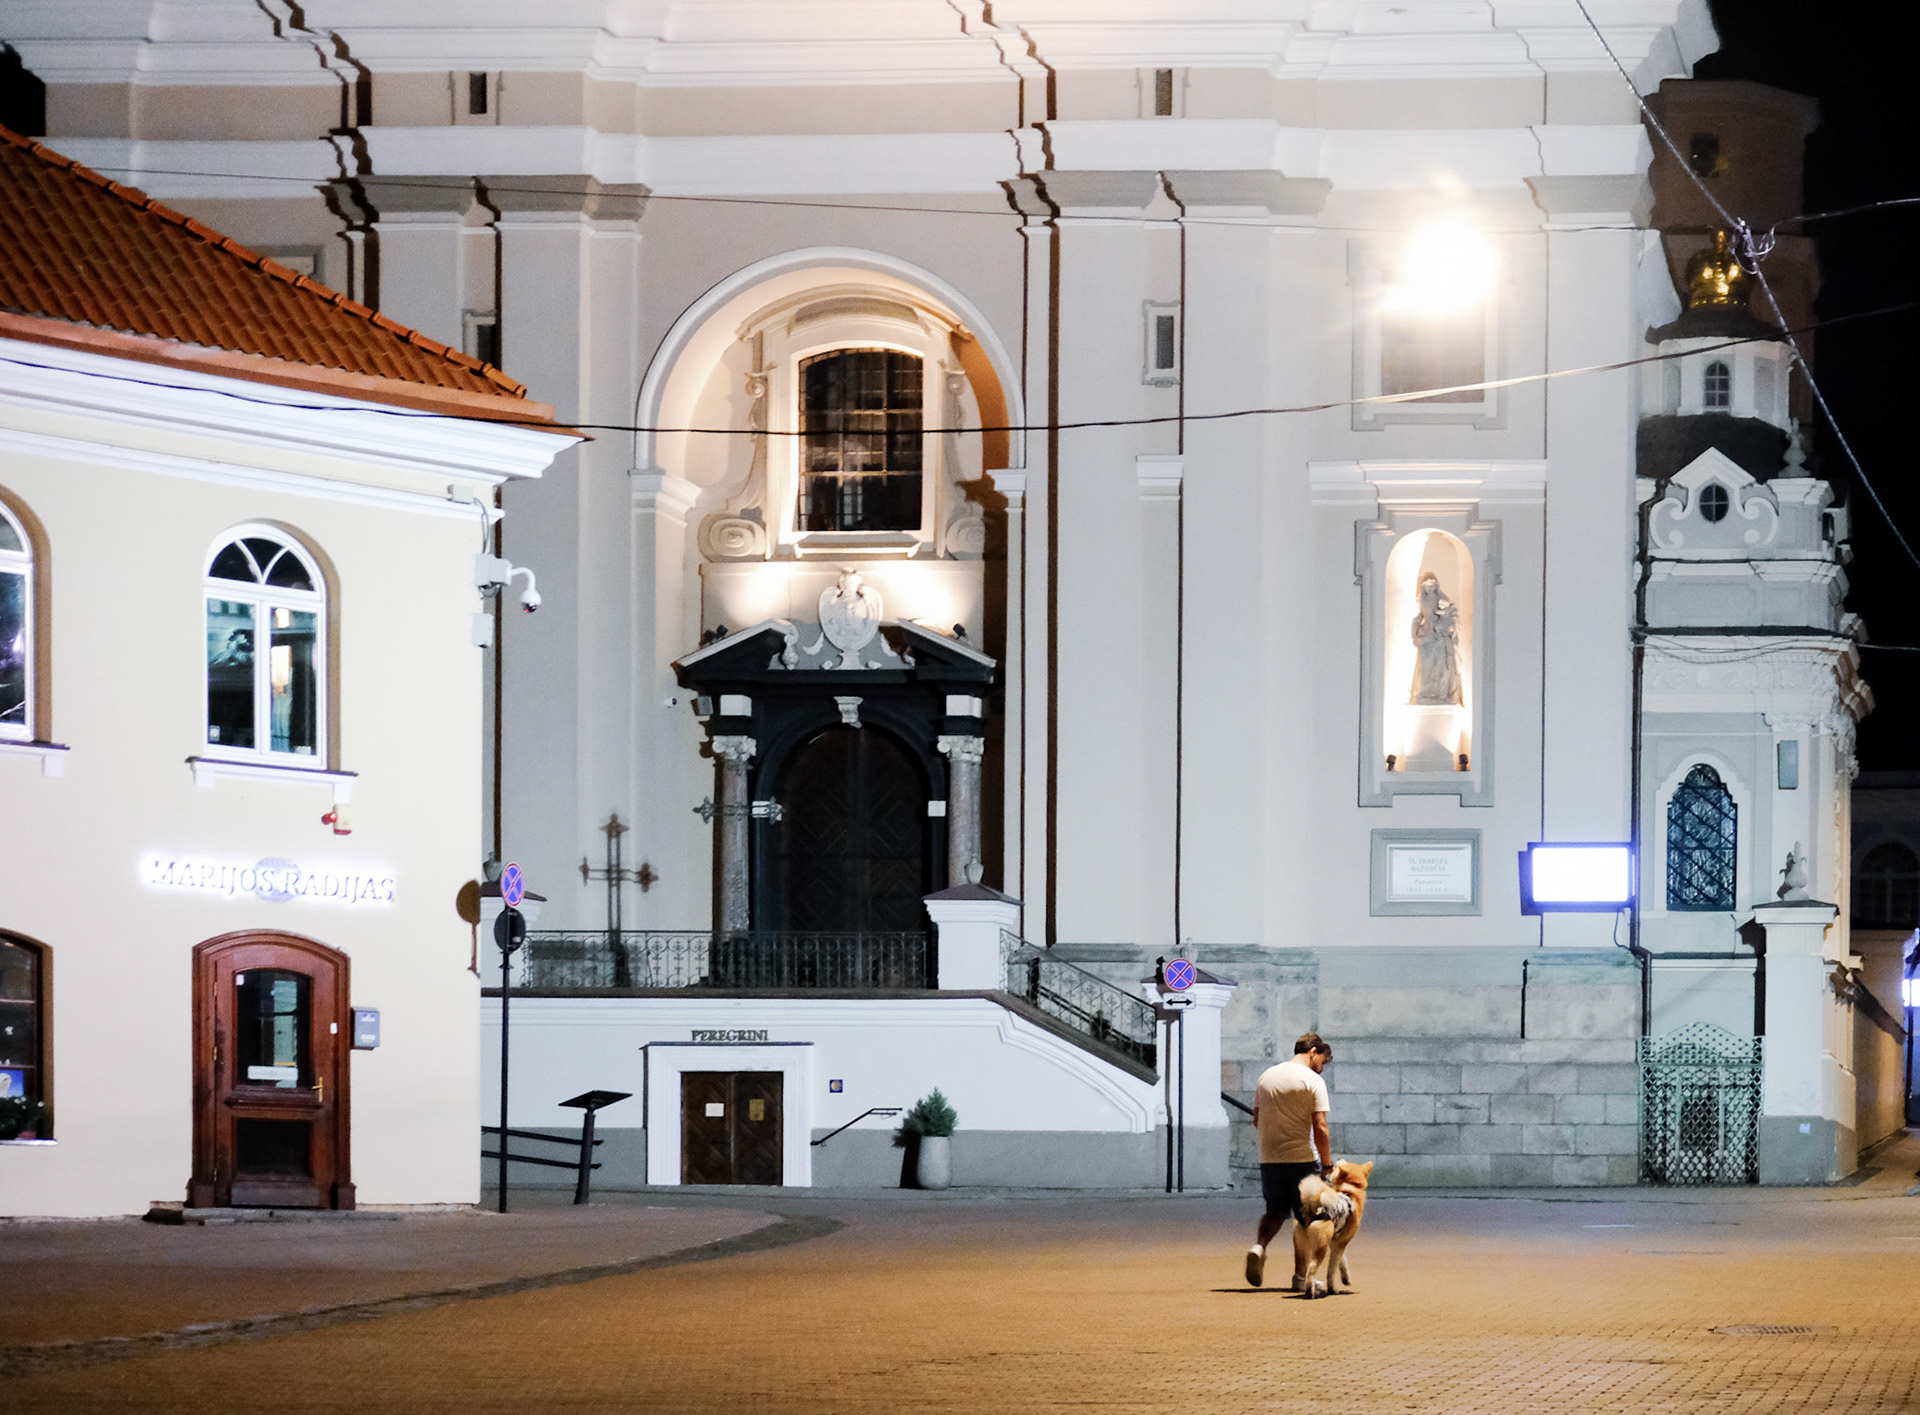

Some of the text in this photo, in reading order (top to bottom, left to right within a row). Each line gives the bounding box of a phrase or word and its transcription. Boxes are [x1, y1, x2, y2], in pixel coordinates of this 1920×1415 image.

[151, 859, 395, 904] MARIJOS RADIJAS
[691, 1029, 769, 1041] PEREGRINI
